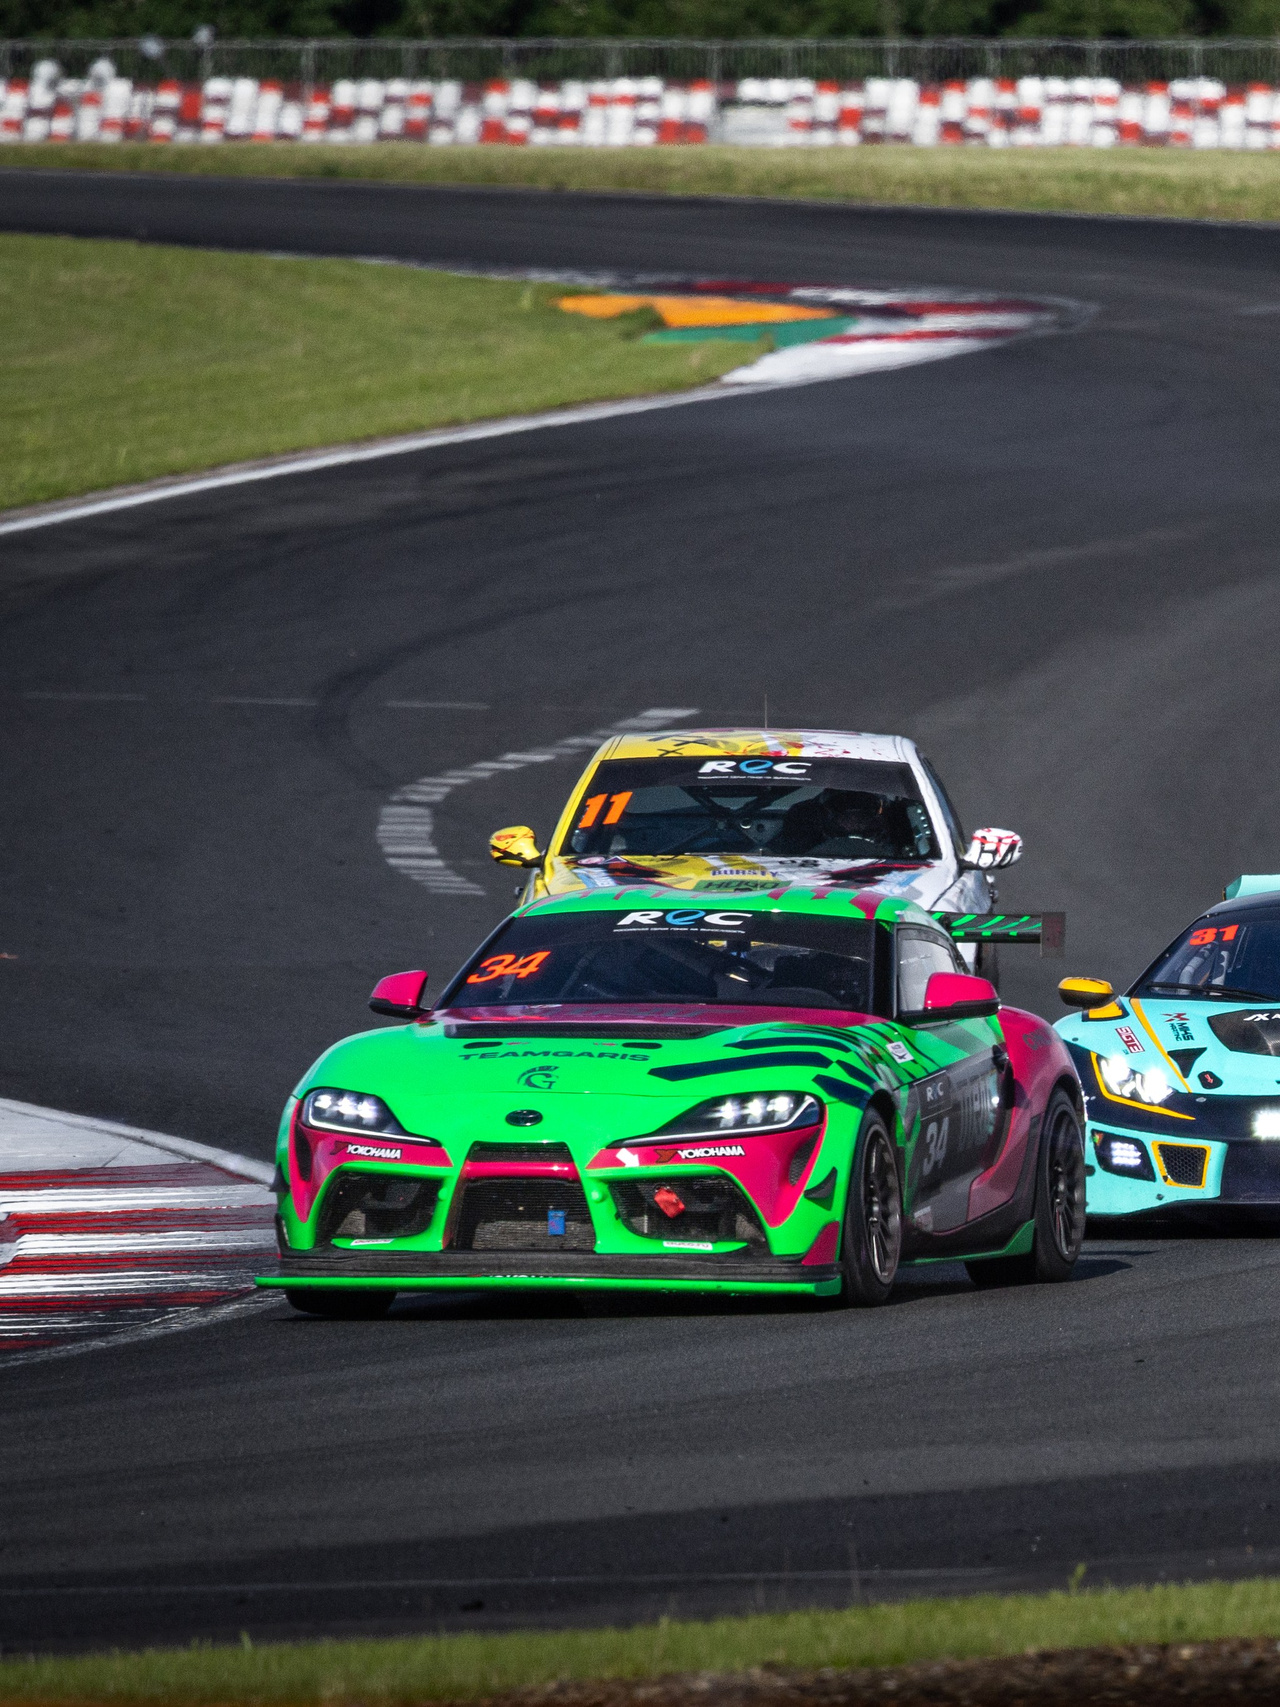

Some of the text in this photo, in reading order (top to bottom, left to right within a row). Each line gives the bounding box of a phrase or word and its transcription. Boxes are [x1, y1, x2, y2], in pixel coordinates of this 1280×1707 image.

[578, 792, 633, 829] 11
[467, 951, 551, 983] 34
[459, 1051, 650, 1061] TEAMGARIS
[346, 1144, 402, 1159] YOKOHAMA
[677, 1145, 746, 1160] YOKOHAMA
[922, 1117, 949, 1177] 34
